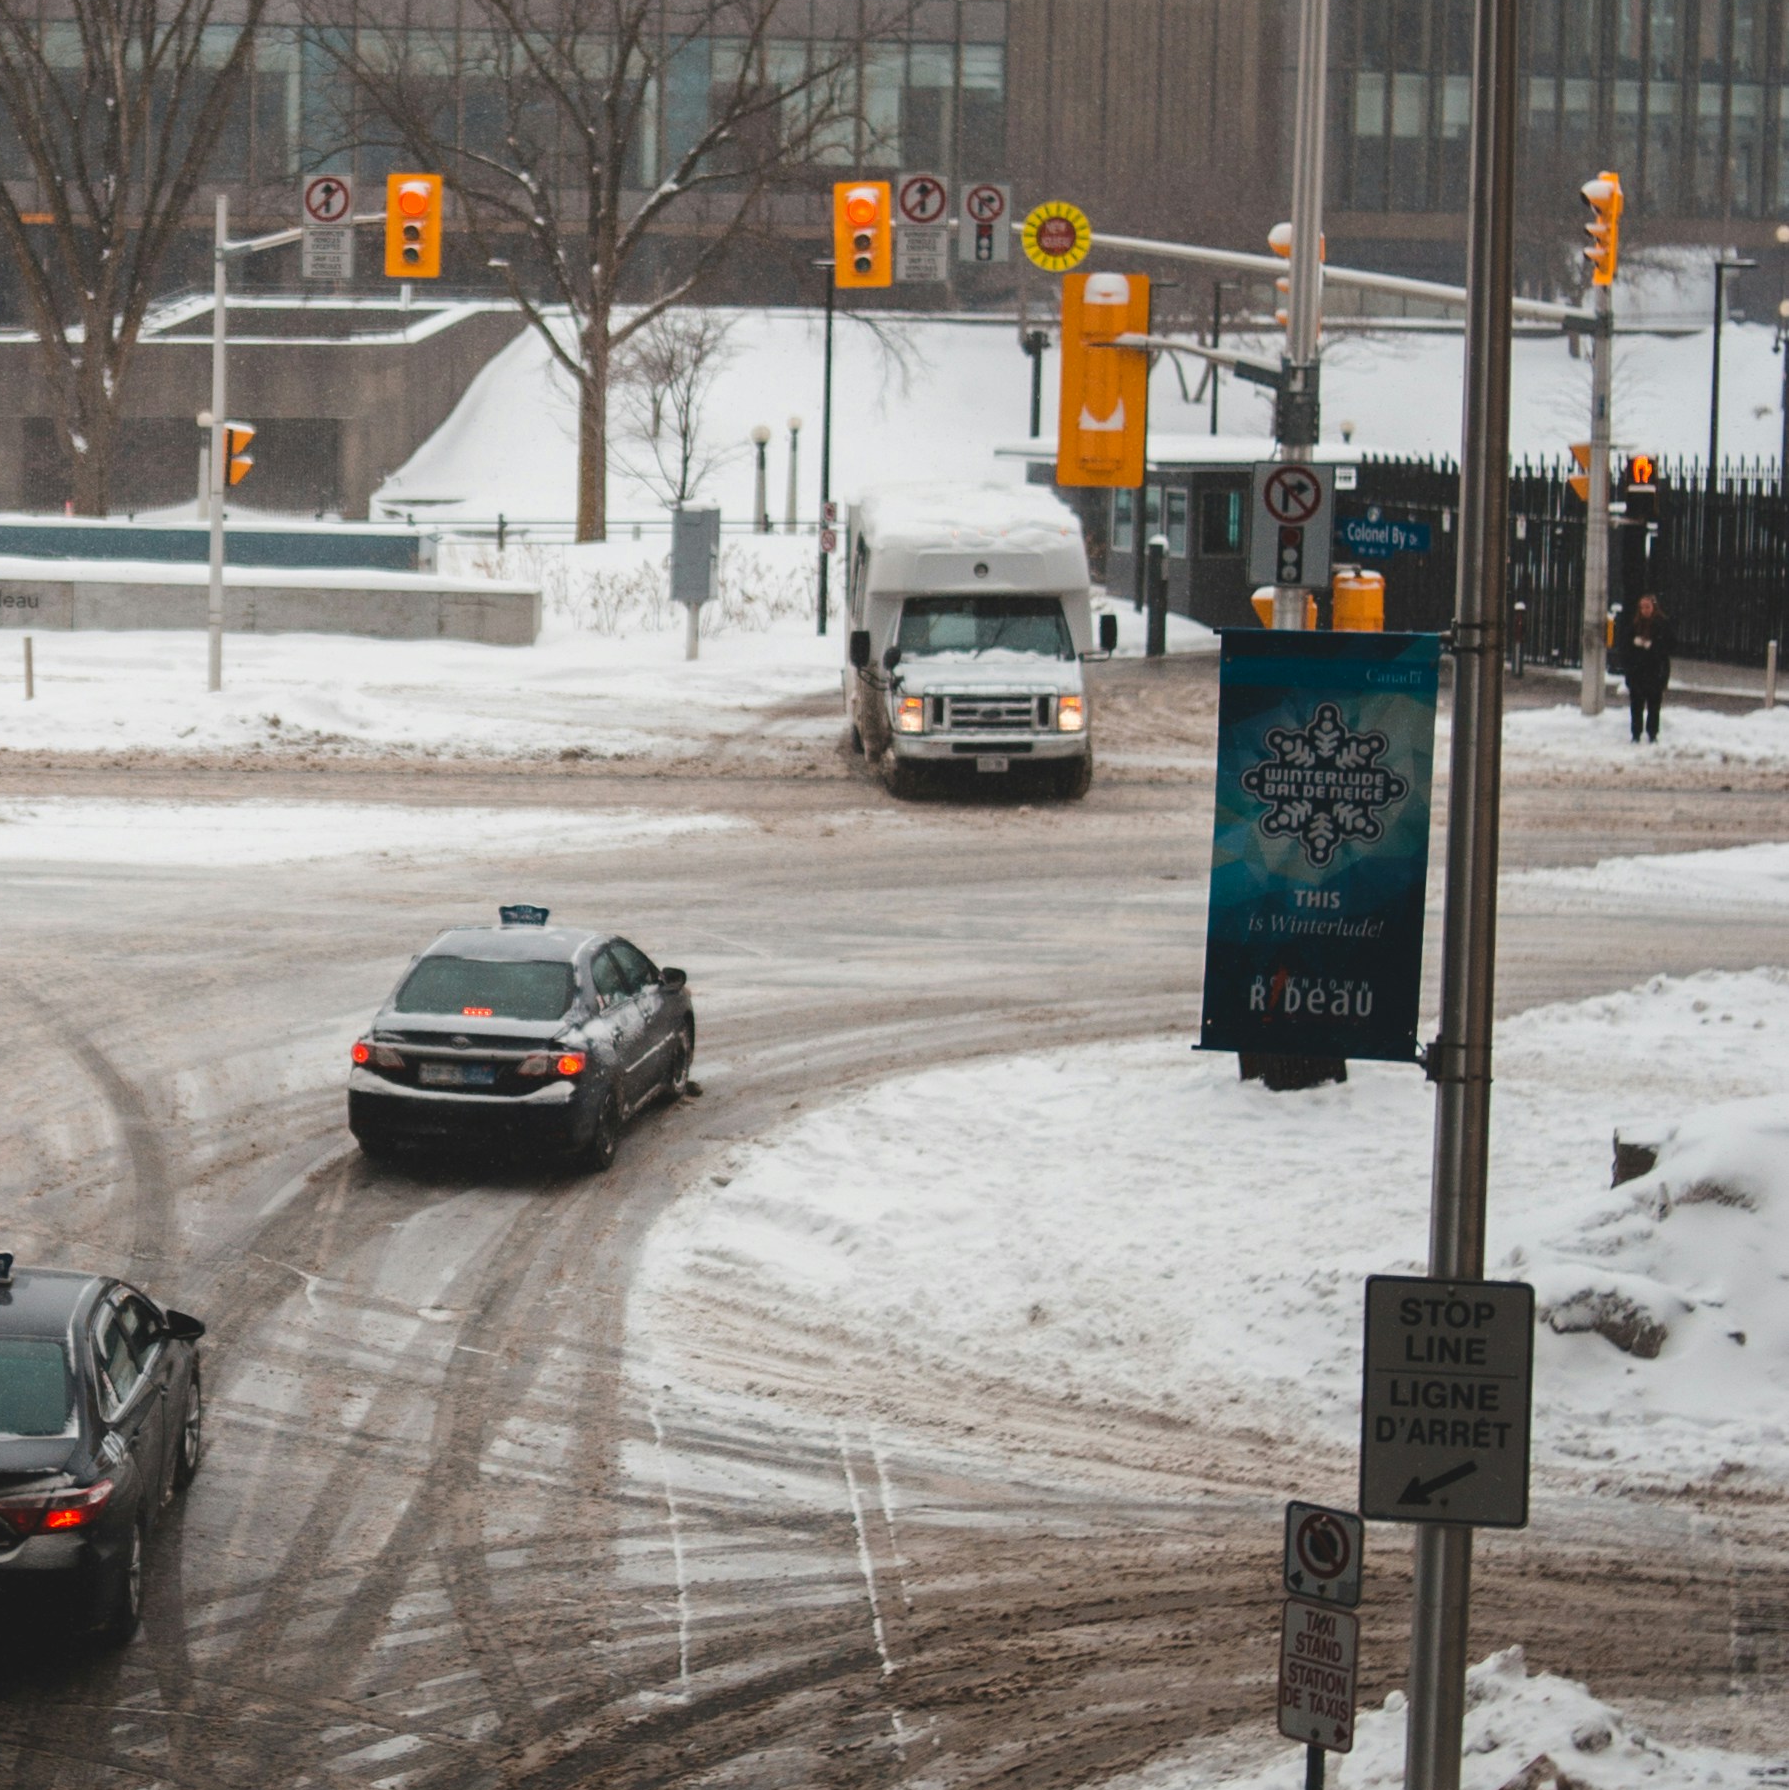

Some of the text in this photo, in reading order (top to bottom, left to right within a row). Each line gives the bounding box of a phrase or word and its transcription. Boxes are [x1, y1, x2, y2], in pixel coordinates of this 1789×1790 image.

[1347, 522, 1389, 544] Colonel
[1392, 526, 1406, 550] By
[1366, 669, 1422, 685] Canada
[1264, 768, 1385, 787] WINTERLUDE
[1263, 782, 1384, 802] BAL DE NEIGE
[1294, 889, 1341, 909] THIS
[1248, 913, 1385, 939] is Winterlude!
[1399, 1297, 1496, 1329] STOP
[1405, 1334, 1487, 1365] LINE
[1390, 1379, 1500, 1411] LIGNE
[1305, 1611, 1336, 1638] TAXI
[1295, 1631, 1342, 1663] STAND
[1288, 1661, 1347, 1697] STATION
[1283, 1685, 1349, 1723] DE TAXIS
